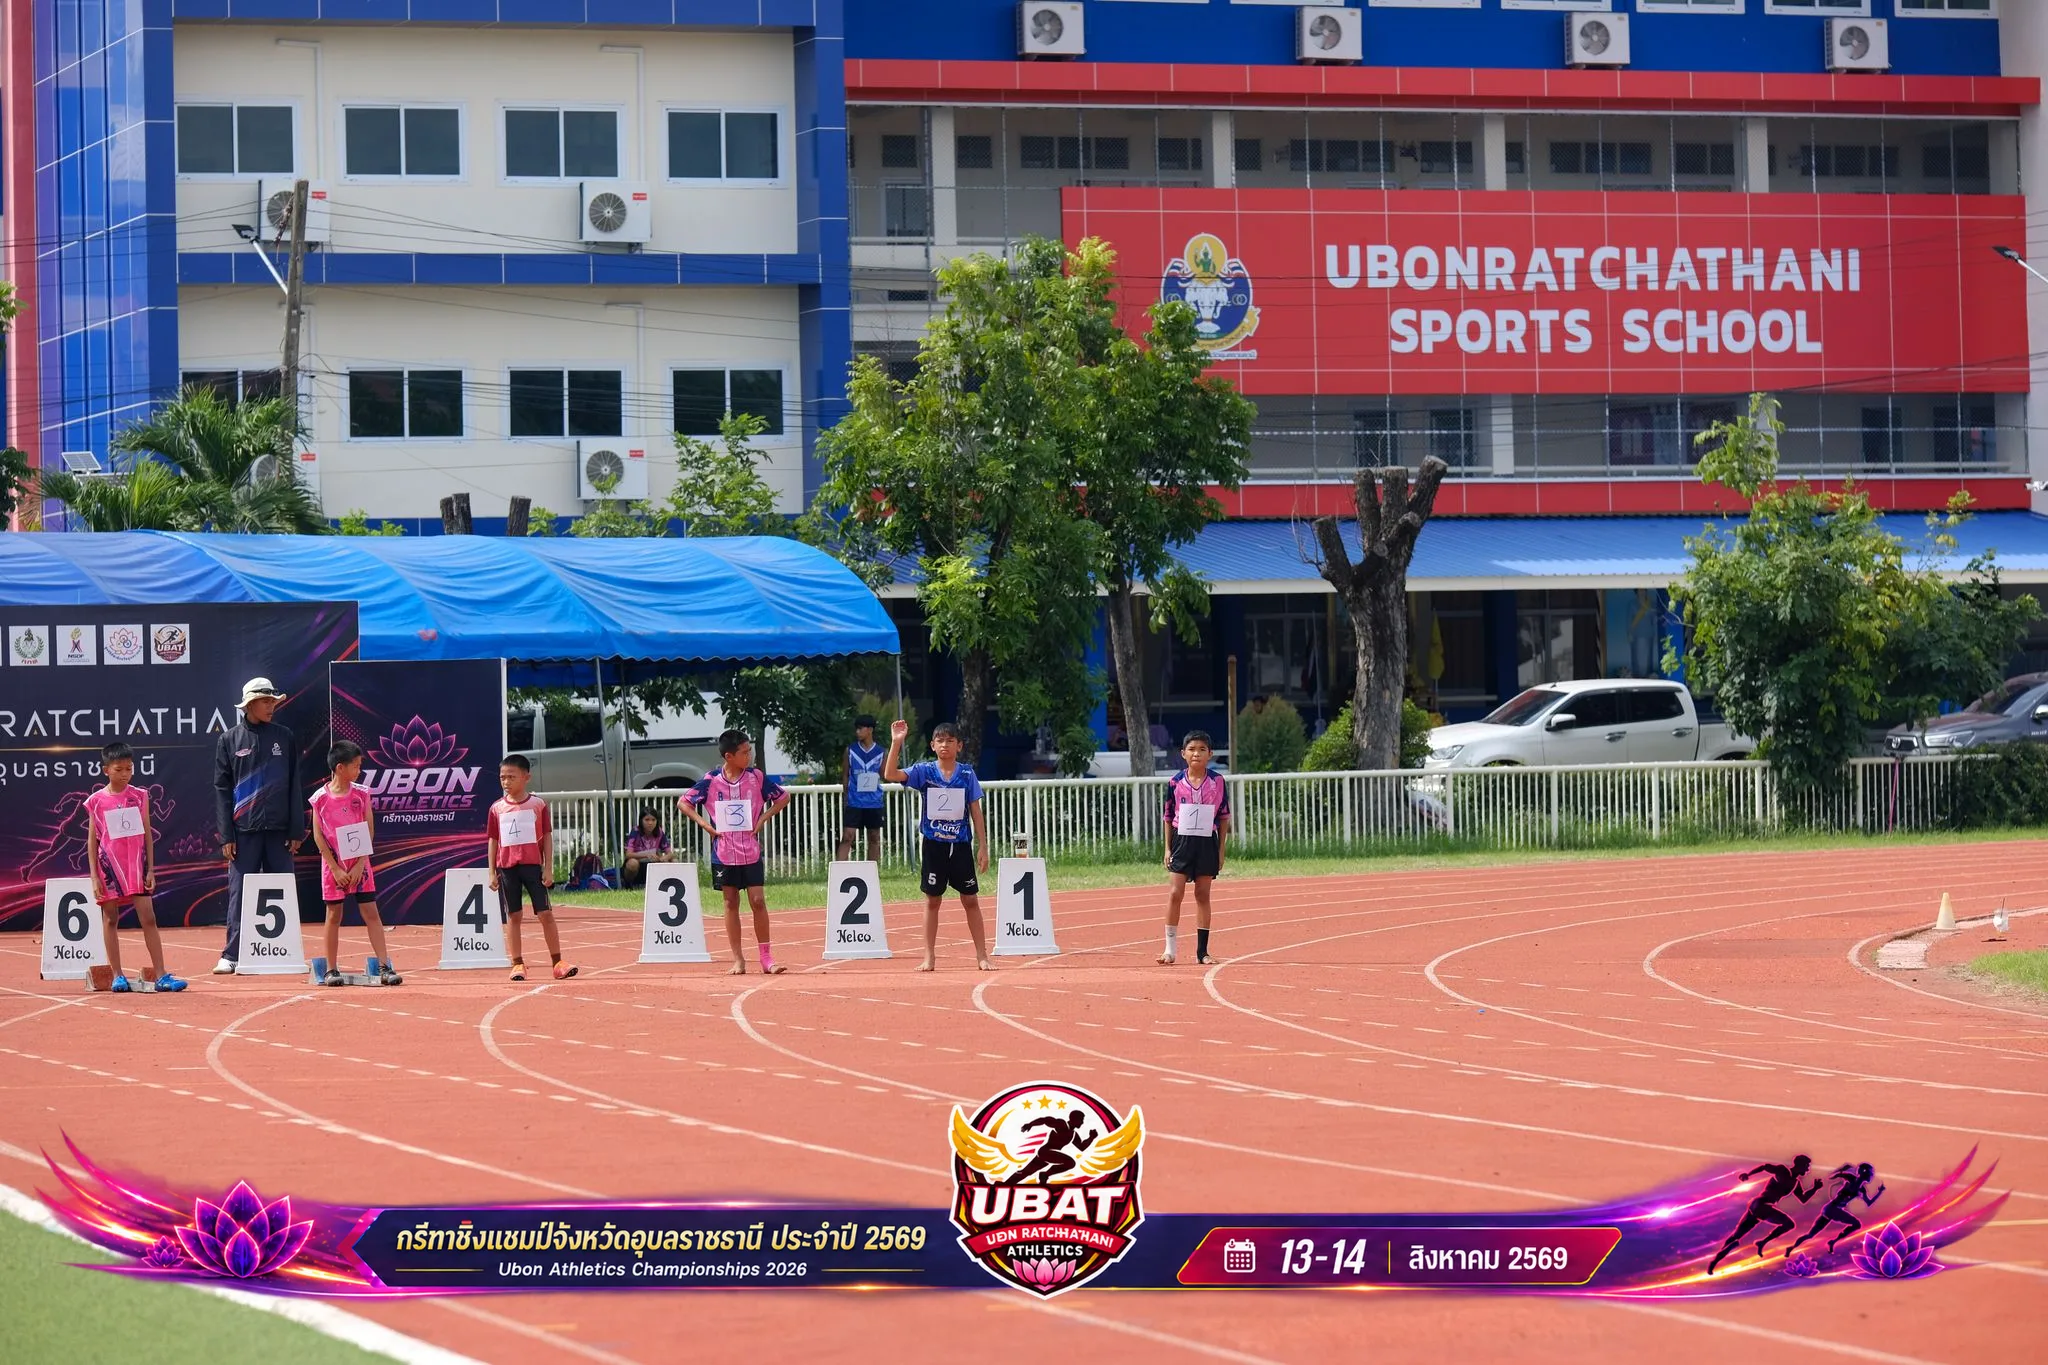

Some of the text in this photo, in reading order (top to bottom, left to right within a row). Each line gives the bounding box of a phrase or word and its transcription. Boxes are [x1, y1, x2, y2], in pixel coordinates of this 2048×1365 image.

[1325, 244, 1861, 292] UBONRATCHATHANI
[1389, 308, 1823, 354] SPORTS SCHOOL
[157, 644, 183, 652] UBAT
[361, 766, 483, 795] UBON
[937, 793, 953, 812] 2
[121, 811, 131, 830] 6
[726, 803, 746, 827] 3
[1189, 808, 1199, 830] 1
[508, 818, 522, 838] 4
[346, 830, 361, 853] 5
[927, 872, 937, 886] 5
[657, 877, 689, 927] 3
[839, 876, 870, 925] 2
[1012, 871, 1035, 921] 1
[57, 891, 90, 942] 6
[254, 888, 286, 939] 5
[457, 883, 488, 934] 4
[837, 929, 872, 943] Nelco
[1006, 922, 1040, 937] Nelco
[53, 945, 92, 960] Nelco
[250, 942, 288, 957] Nelco
[453, 937, 490, 951] Nelco
